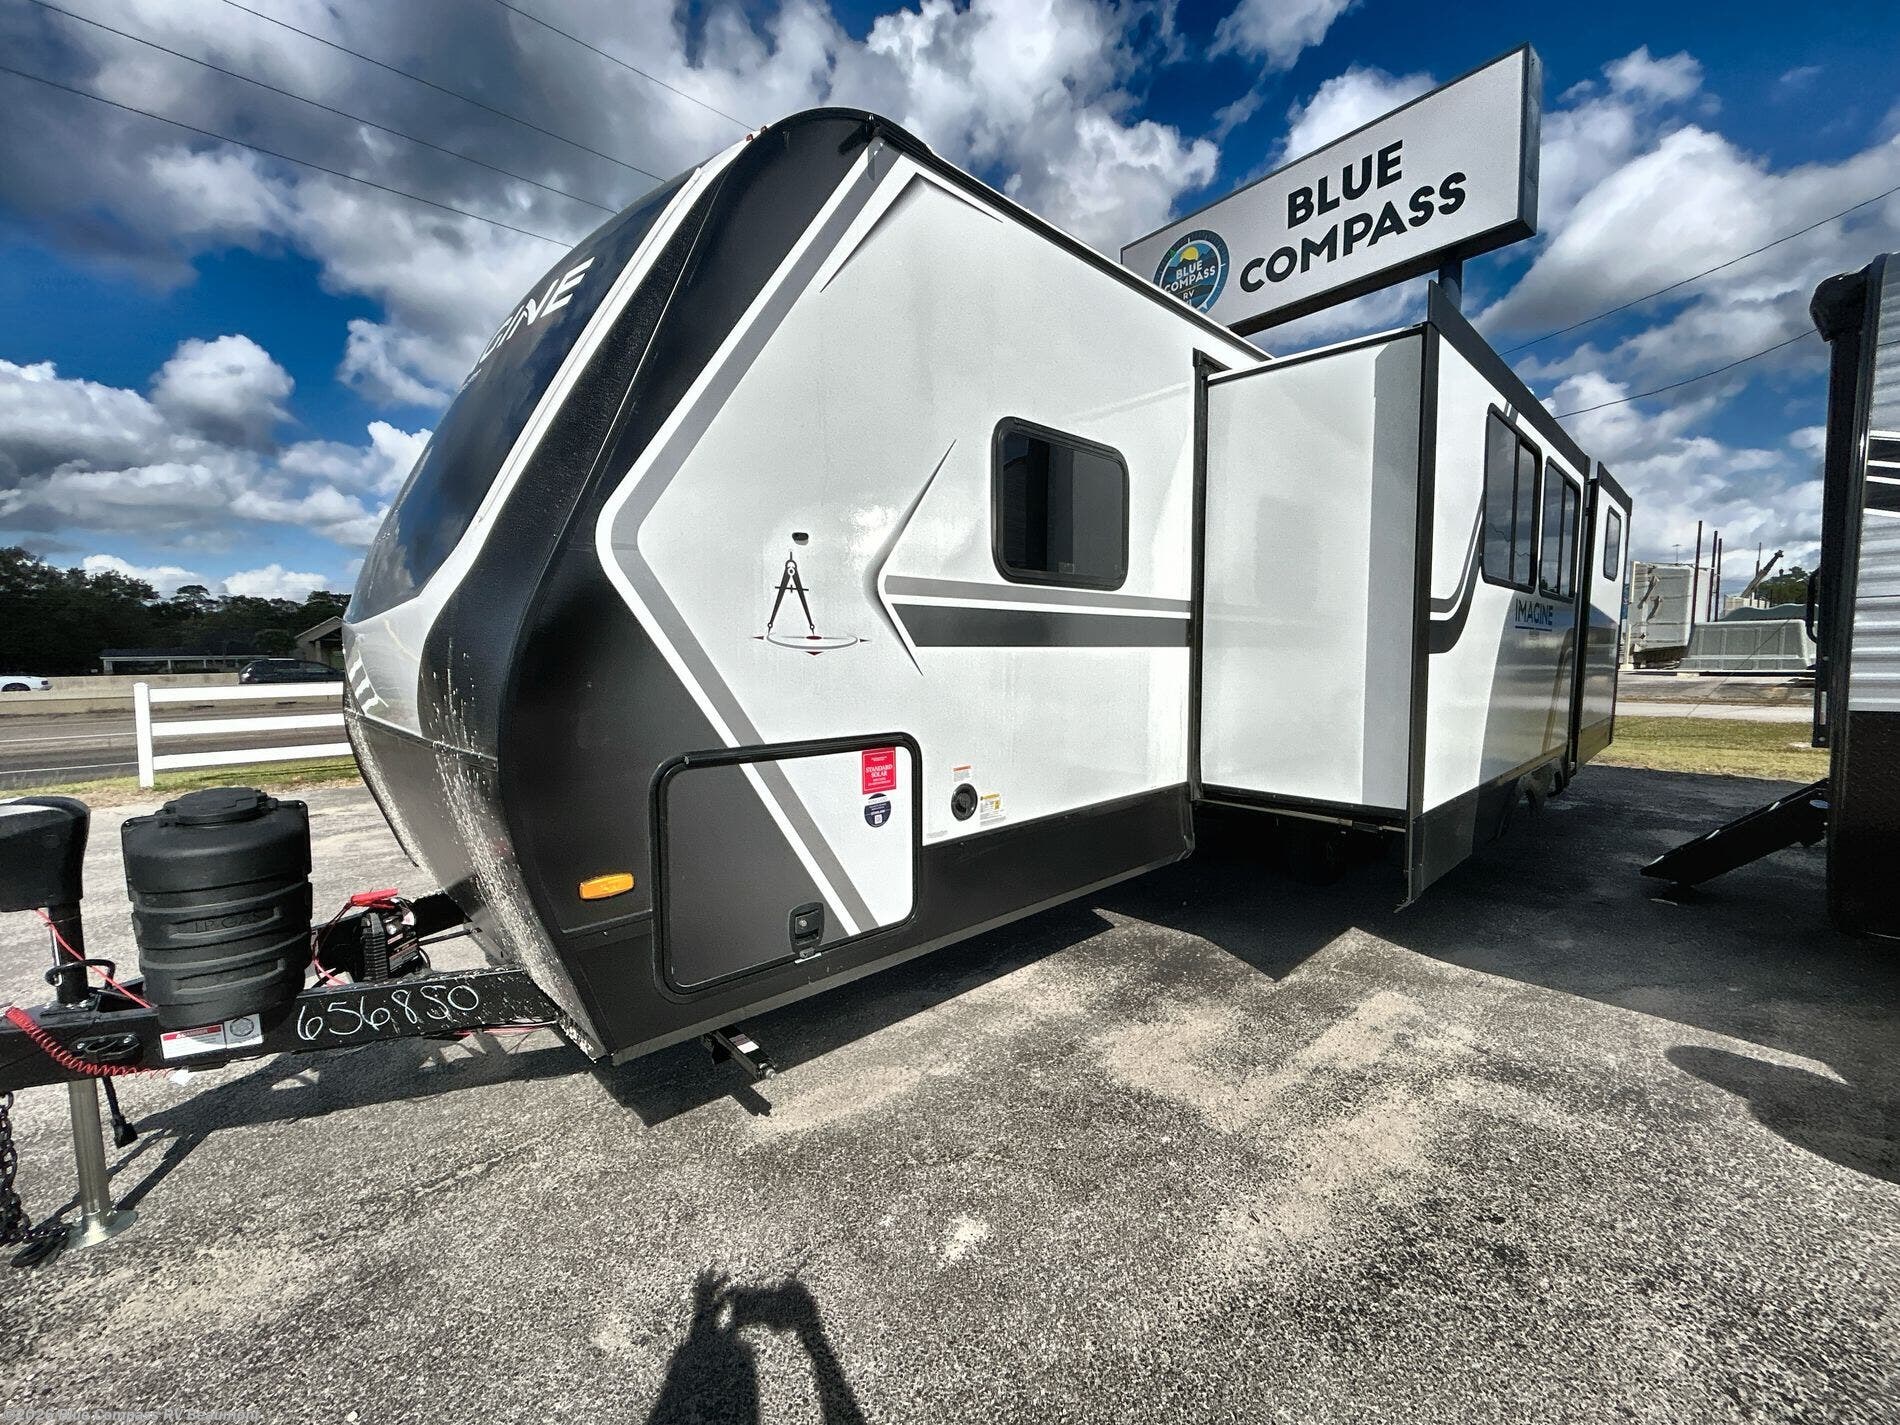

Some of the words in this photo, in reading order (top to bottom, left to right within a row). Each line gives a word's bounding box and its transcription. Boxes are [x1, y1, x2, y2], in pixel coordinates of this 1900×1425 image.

[1287, 139, 1403, 229] BLUE
[1239, 171, 1467, 293] COMPASS
[1164, 265, 1216, 293] COMPASS
[1176, 260, 1203, 280] BLUE
[1182, 289, 1196, 300] RV
[1514, 598, 1555, 626] IMAGINE
